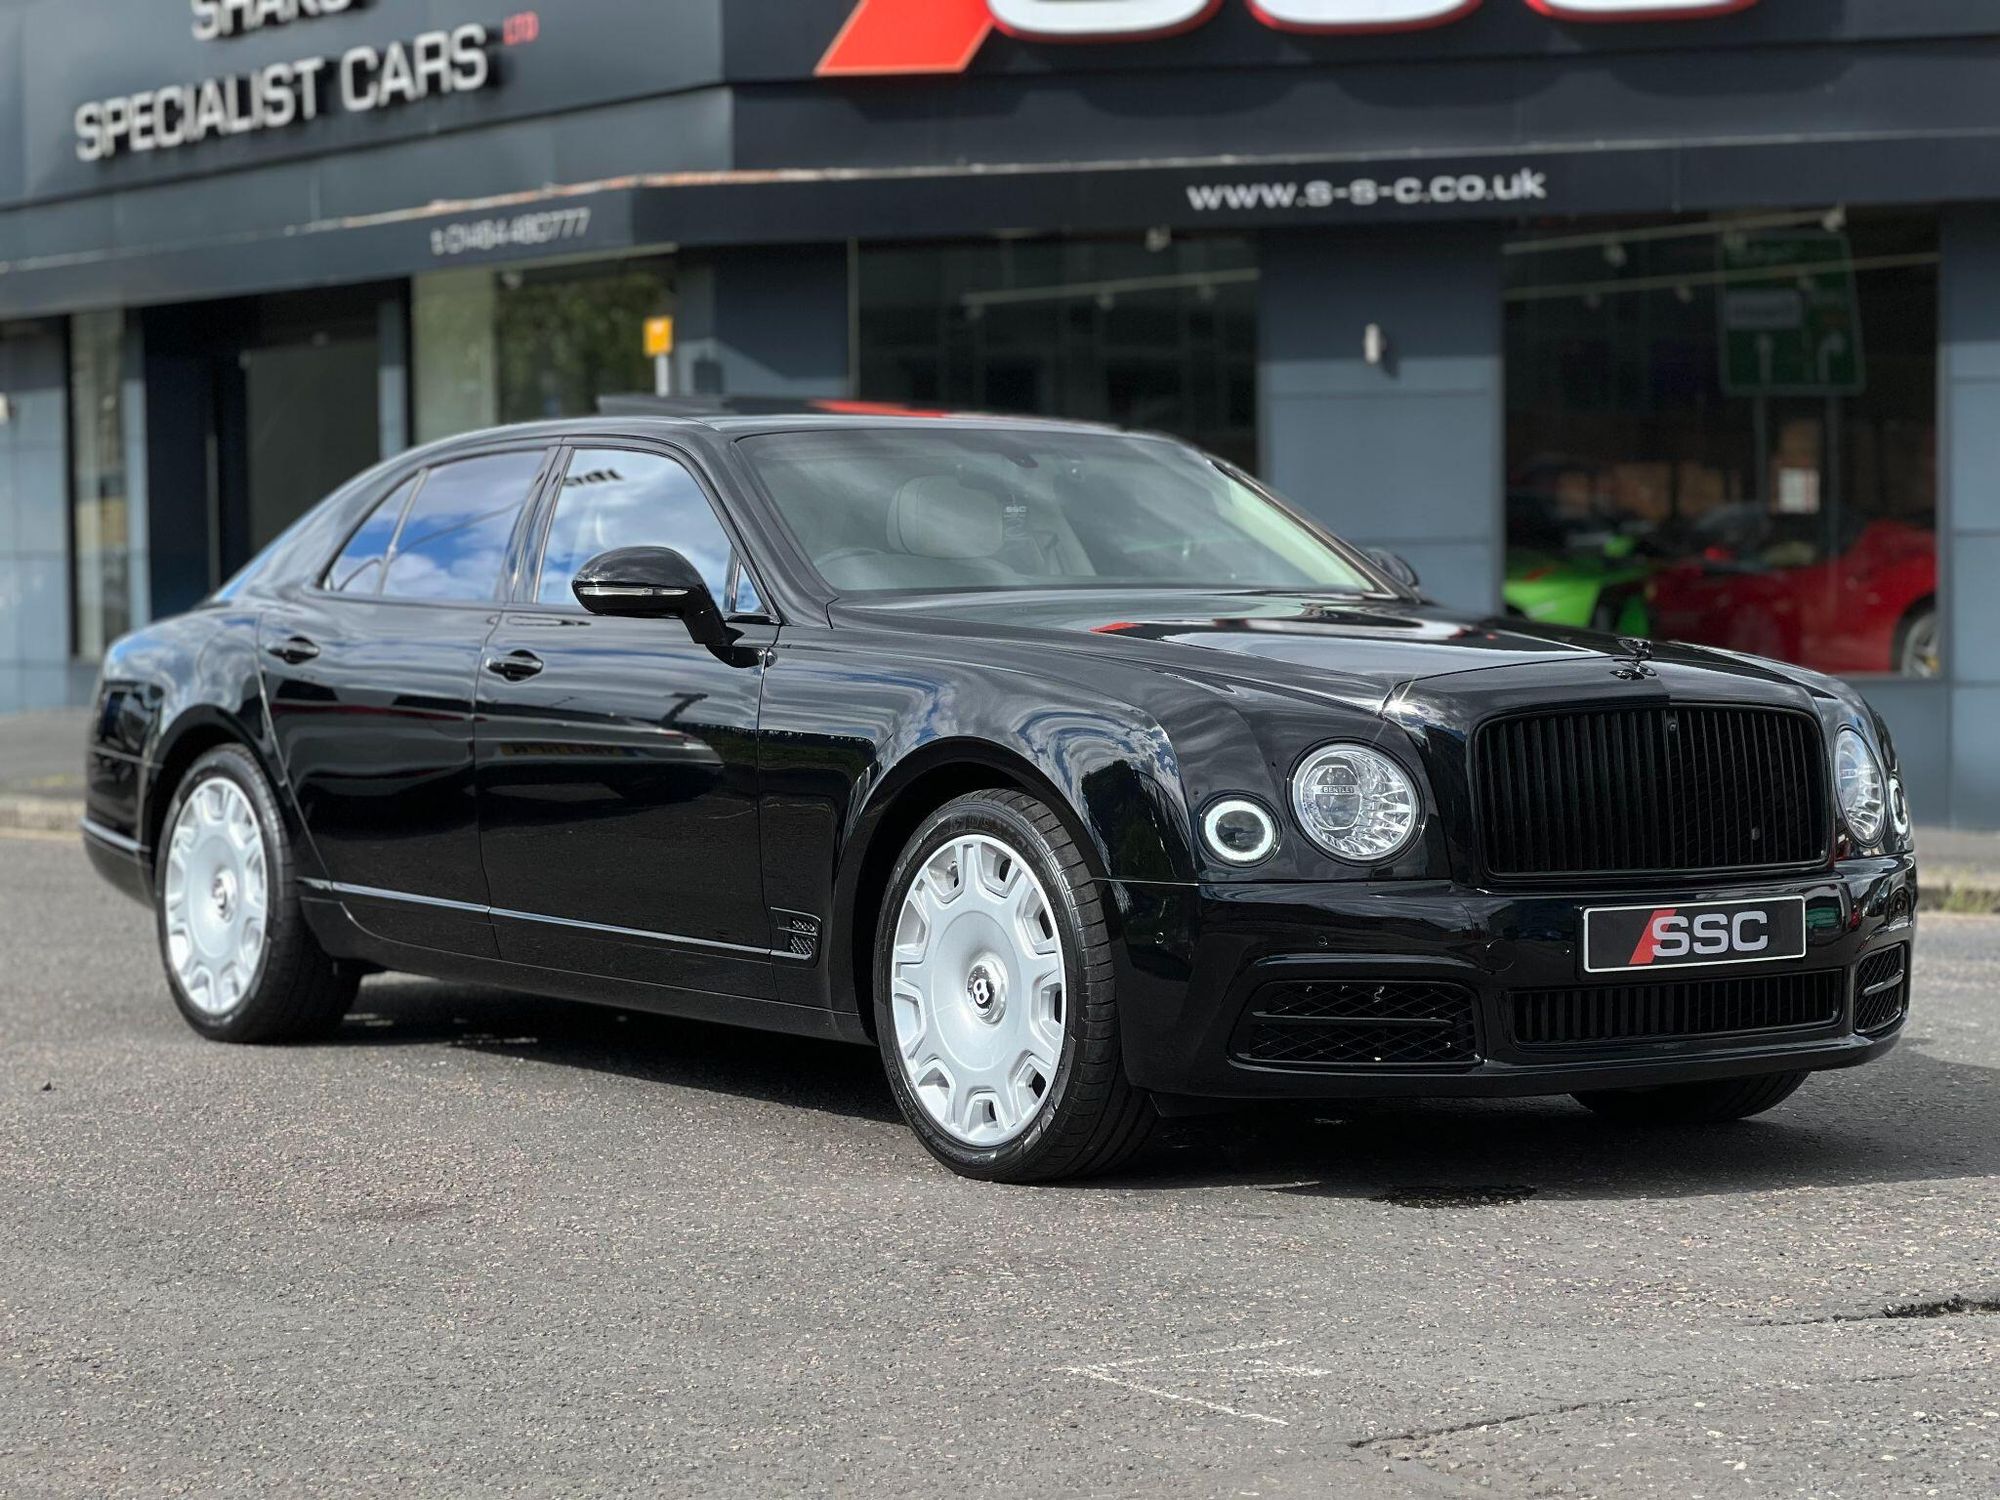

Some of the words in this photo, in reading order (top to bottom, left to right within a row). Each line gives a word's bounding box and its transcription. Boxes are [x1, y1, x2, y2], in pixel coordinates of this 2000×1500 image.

[75, 57, 324, 161] SPECIALIST
[340, 23, 489, 112] CARS
[1187, 167, 1547, 210] www.s-s-c.co.uk
[1652, 910, 1768, 957] SSC
